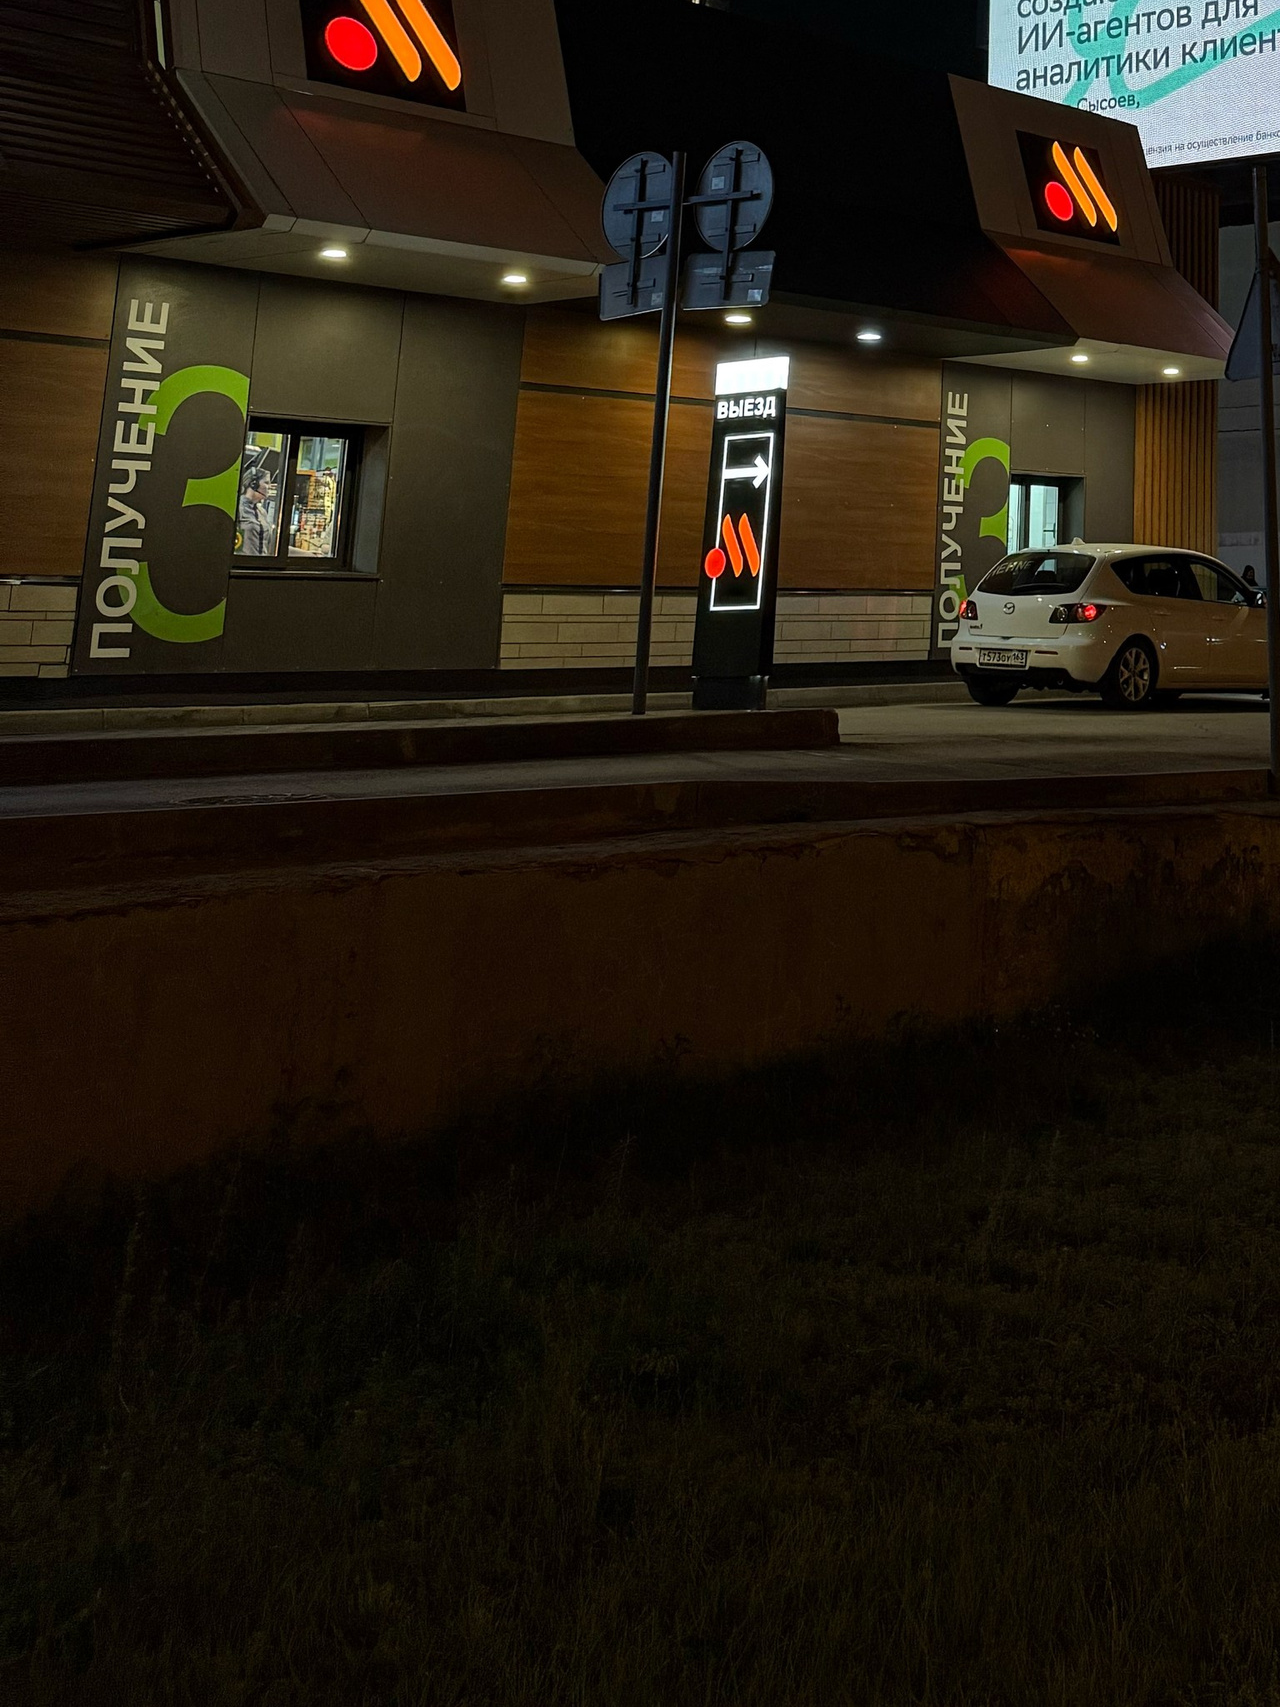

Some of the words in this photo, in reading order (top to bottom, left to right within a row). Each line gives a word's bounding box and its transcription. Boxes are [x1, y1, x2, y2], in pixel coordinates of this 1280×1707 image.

[1018, 5, 1192, 55] ИИ-агентов
[1016, 46, 1170, 91] аналитики
[1174, 144, 1185, 152] на
[1187, 133, 1254, 152] осуществление
[717, 396, 776, 420] ВЫЕЗД
[89, 298, 170, 660] ПОЛУЧЕНИЕ
[938, 391, 968, 648] ПОЛУЧЕНИЕ
